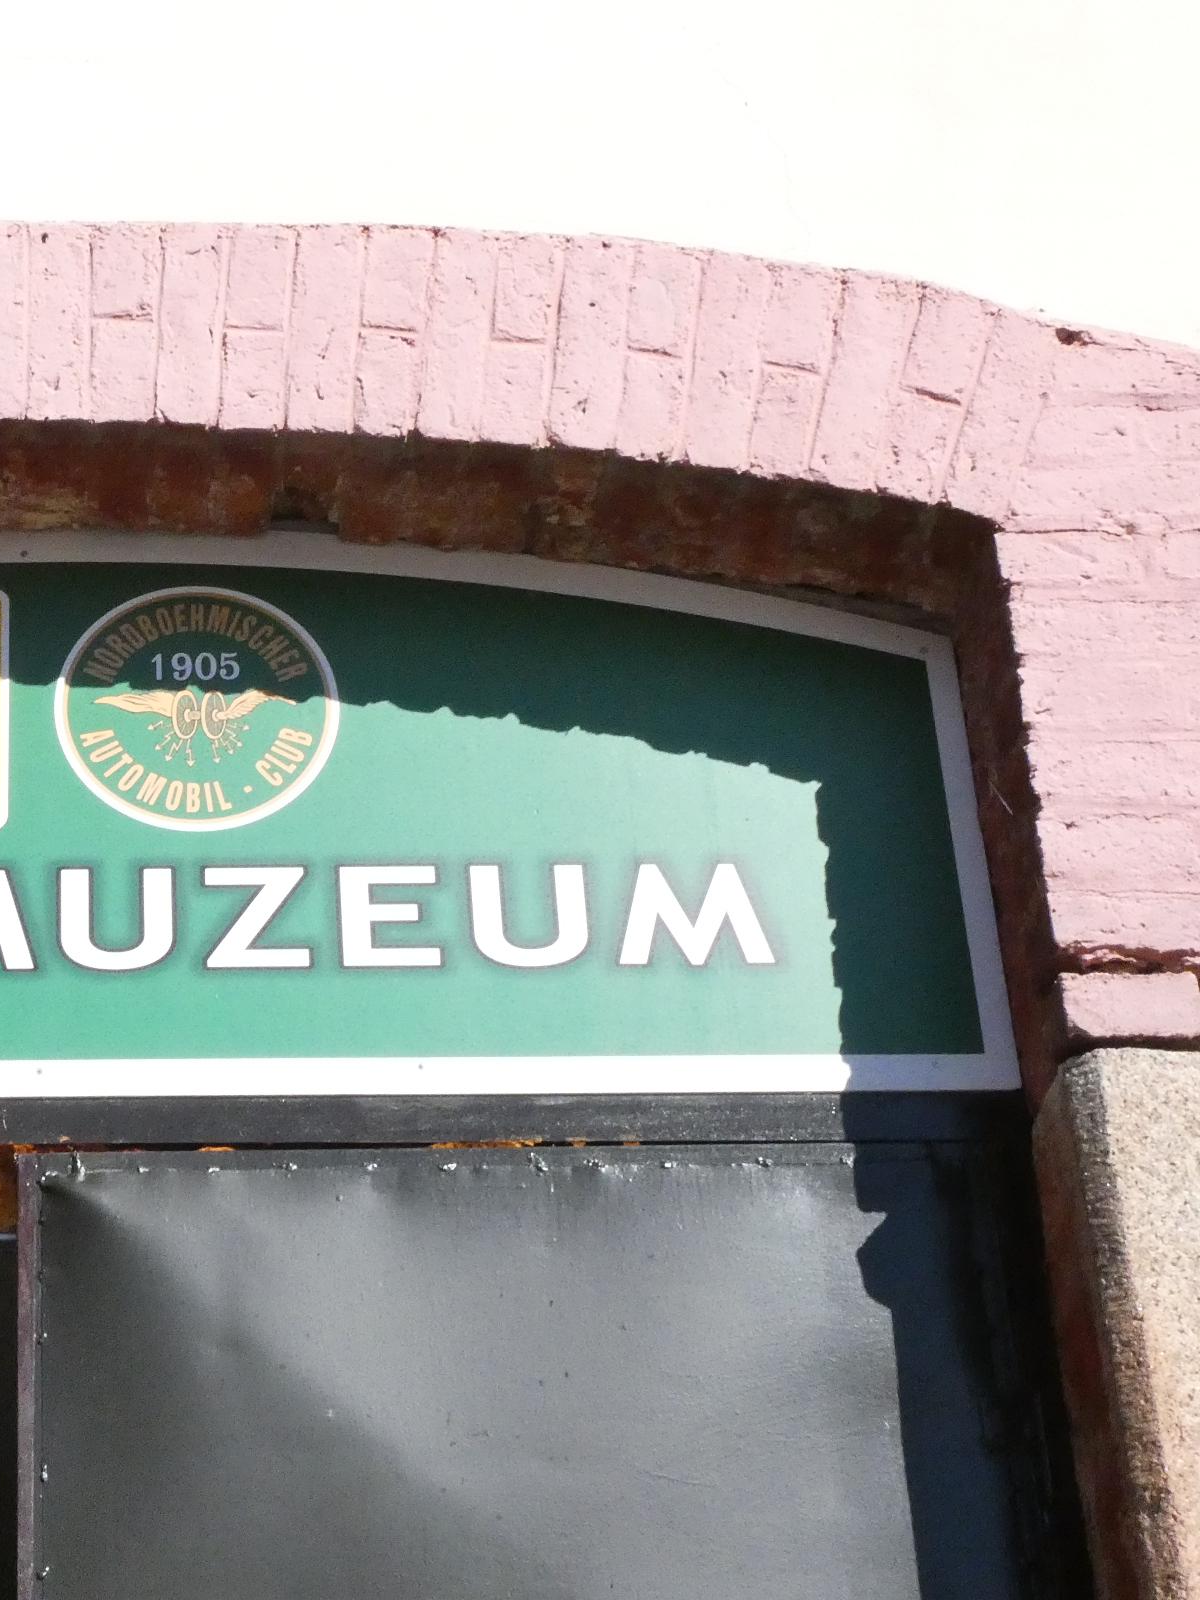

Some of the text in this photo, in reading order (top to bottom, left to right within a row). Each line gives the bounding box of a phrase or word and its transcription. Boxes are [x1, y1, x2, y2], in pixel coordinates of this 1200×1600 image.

[83, 602, 308, 682] NORDBOEHMISCHER
[151, 652, 241, 681] 1905
[80, 728, 313, 813] AUTOMOBIL CLUB
